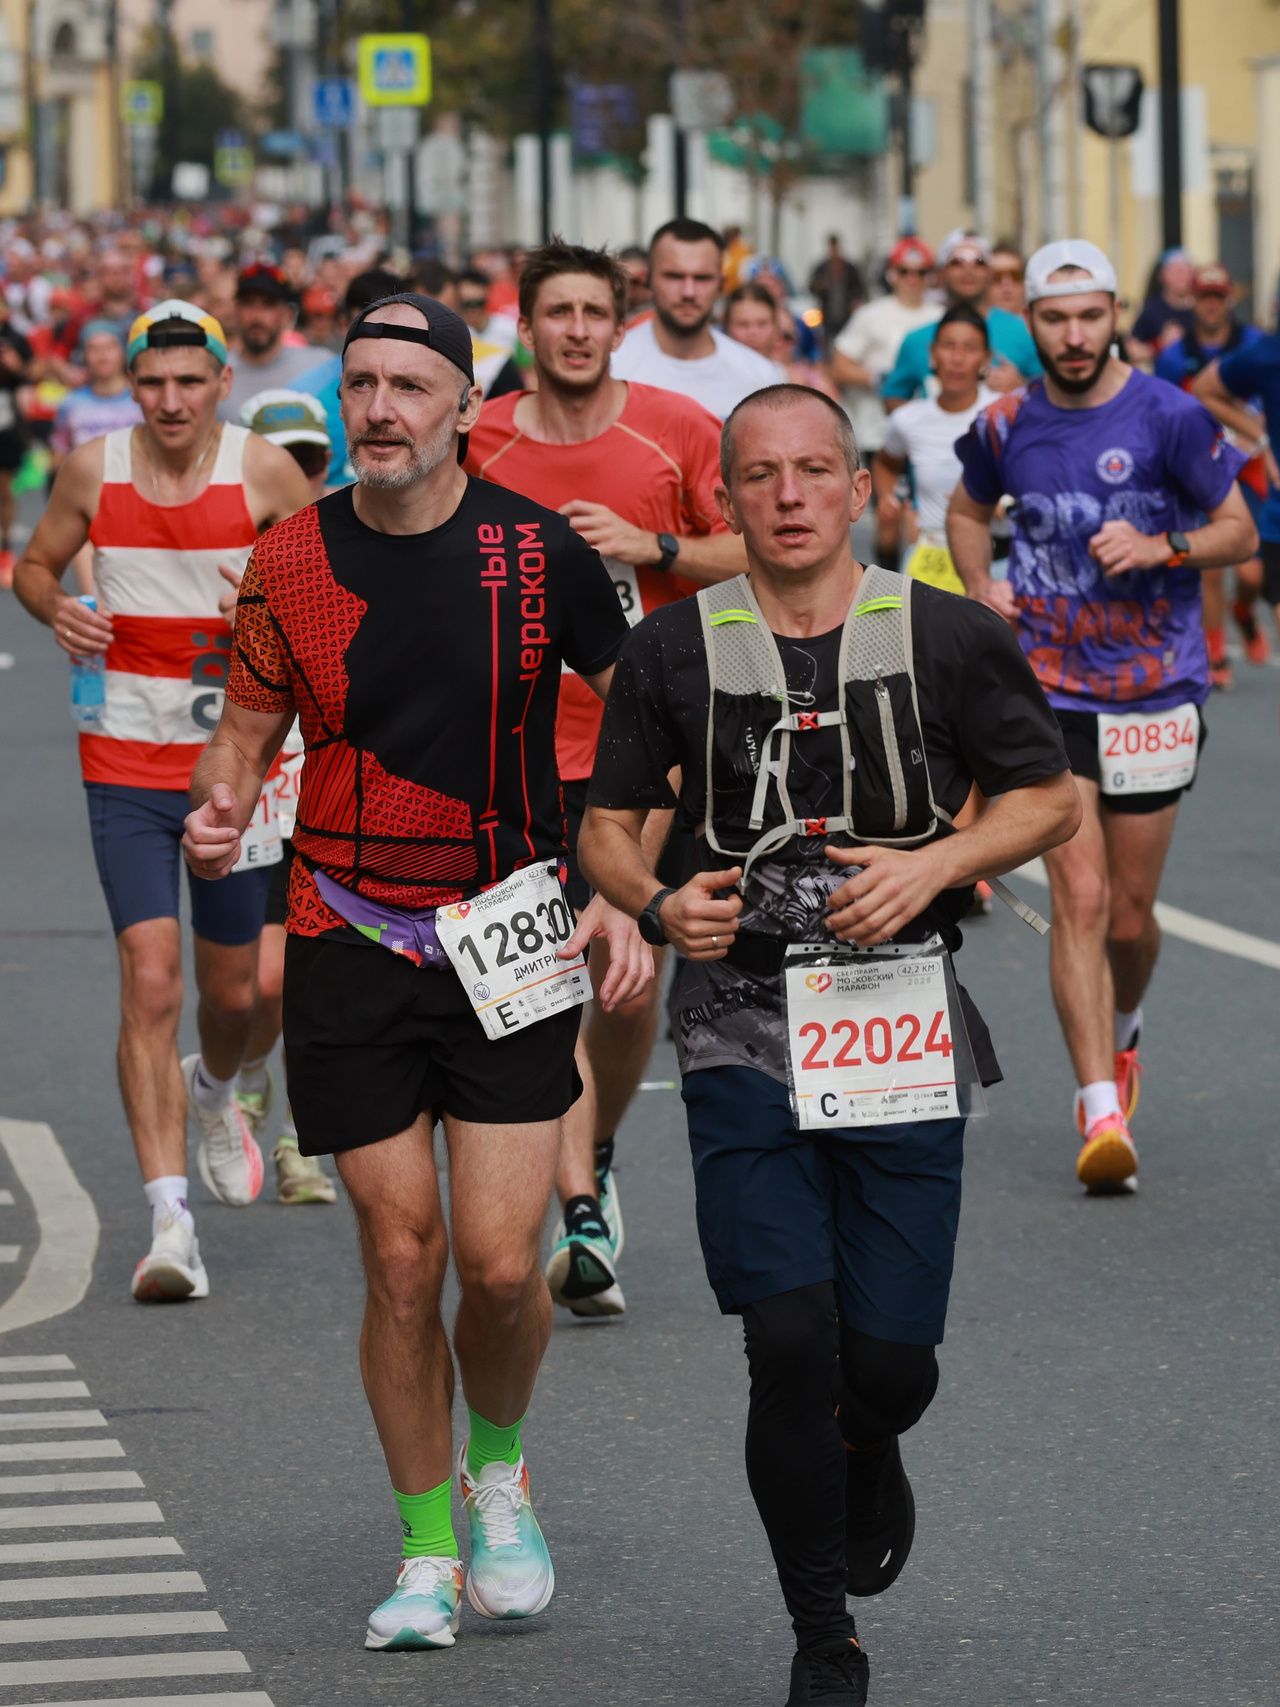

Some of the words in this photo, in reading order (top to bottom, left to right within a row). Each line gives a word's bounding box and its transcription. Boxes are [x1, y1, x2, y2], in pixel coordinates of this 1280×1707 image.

[1104, 717, 1195, 757] 20834
[1112, 771, 1125, 788] G
[248, 844, 258, 862] E
[474, 880, 525, 907] МОСКОВСКИЙ
[477, 892, 515, 912] МАРАФОН
[457, 897, 571, 977] 12830
[836, 967, 879, 977] СБЕРПРАЙМ
[836, 973, 893, 985] МОСКОВСКИЙ
[902, 966, 919, 975] 42,2
[837, 982, 880, 993] МАРАФОН
[495, 1001, 520, 1030] E
[798, 1010, 954, 1070] 22024
[820, 1092, 839, 1118] C
